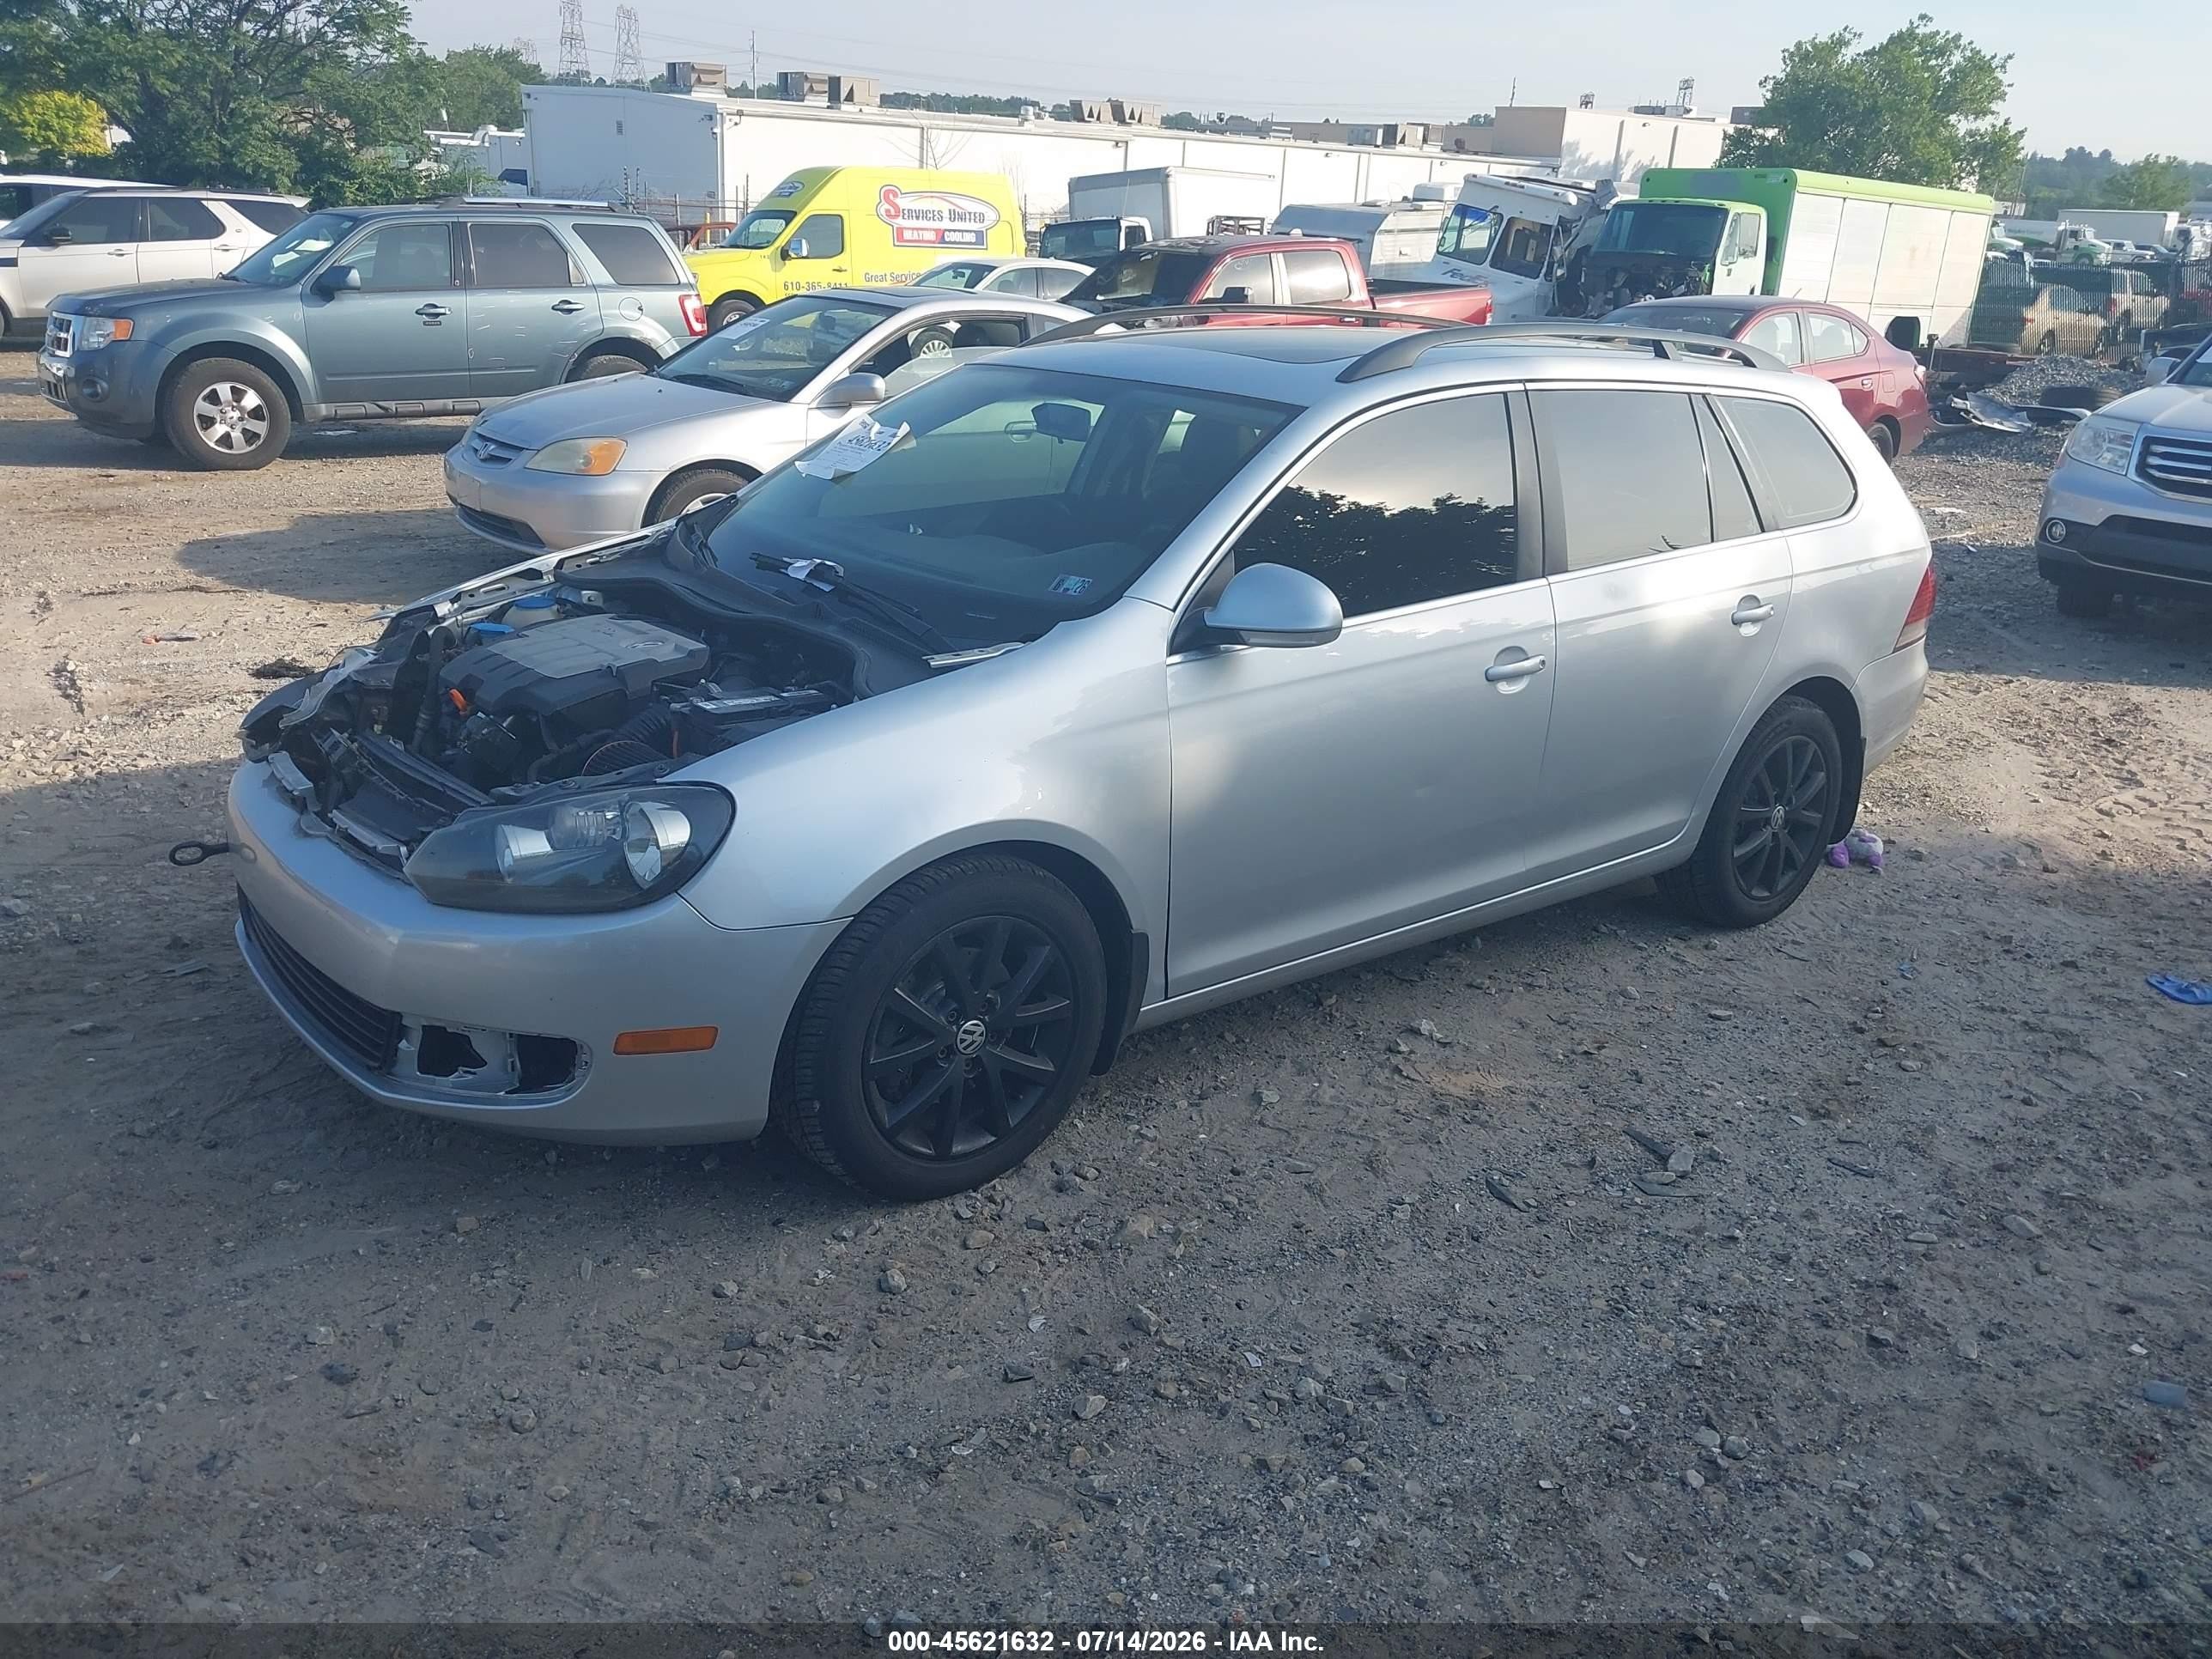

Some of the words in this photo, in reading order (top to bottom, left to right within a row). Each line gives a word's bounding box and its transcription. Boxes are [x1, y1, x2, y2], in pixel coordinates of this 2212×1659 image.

[884, 188, 944, 222] SERVICES
[948, 208, 985, 224] UNITED
[944, 230, 976, 242] COOLING
[864, 272, 887, 283] Great
